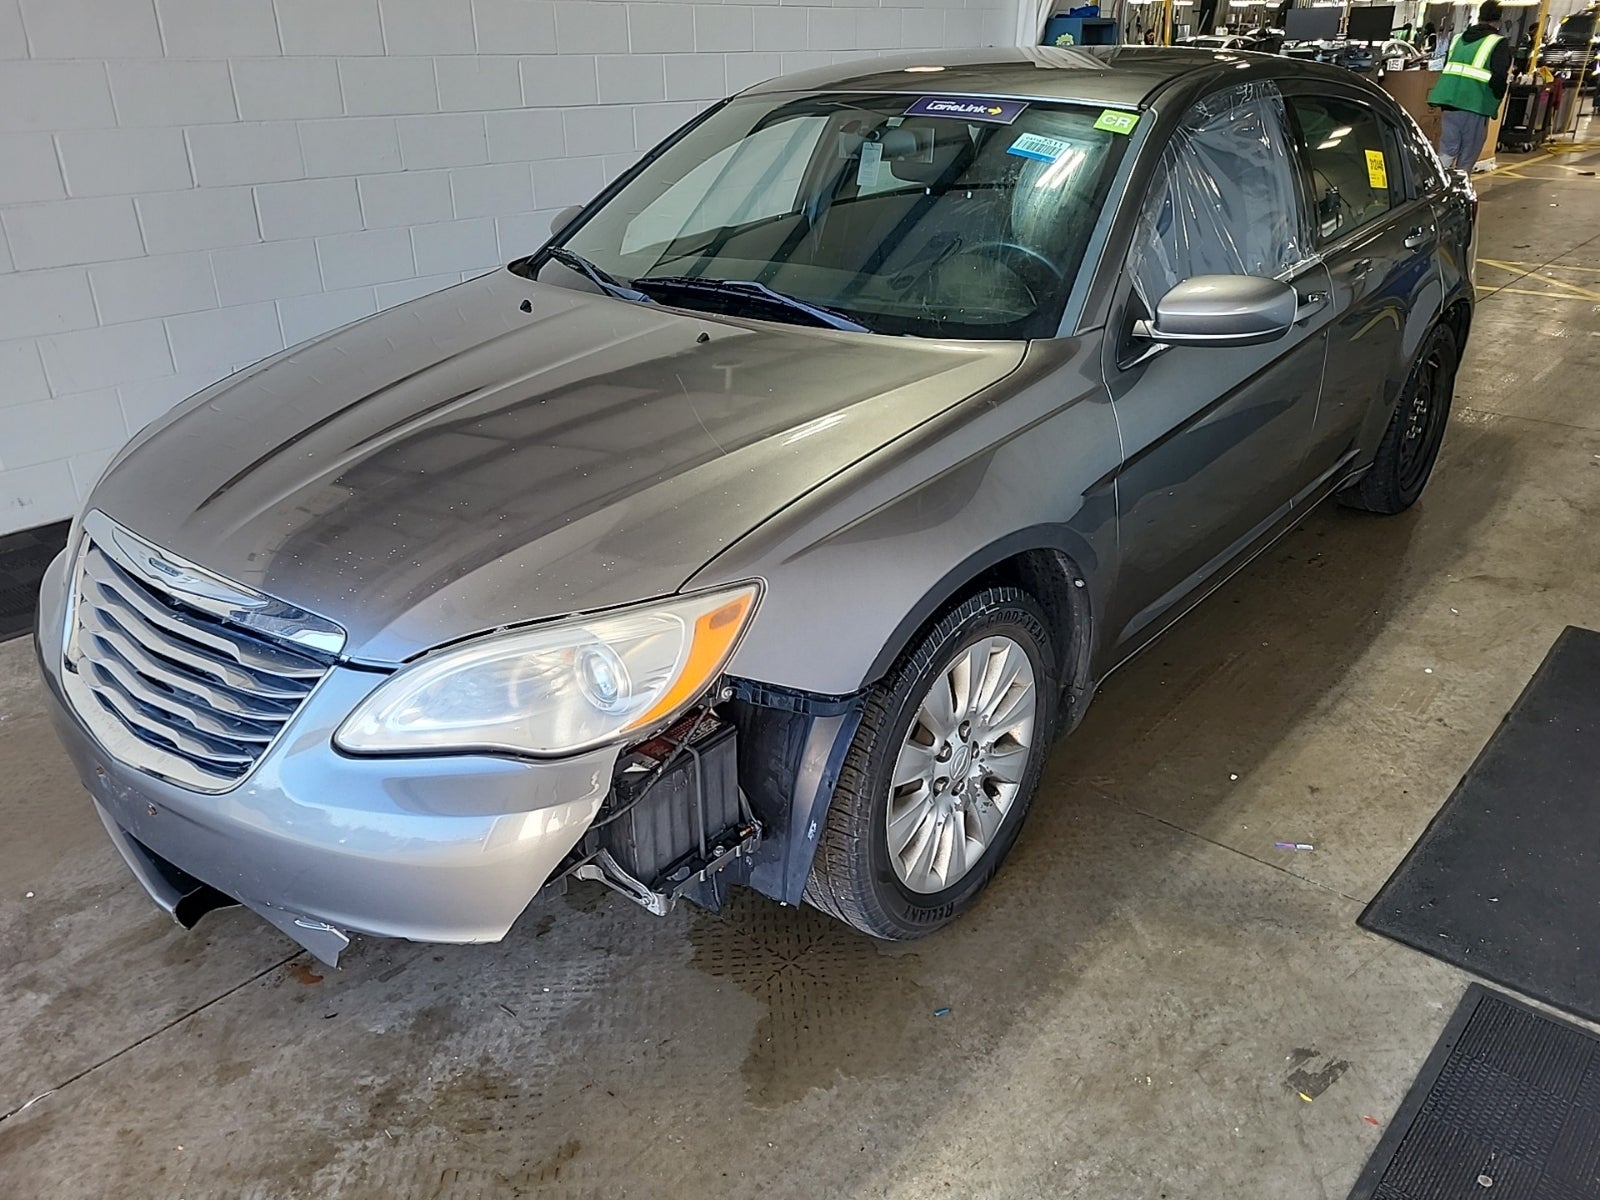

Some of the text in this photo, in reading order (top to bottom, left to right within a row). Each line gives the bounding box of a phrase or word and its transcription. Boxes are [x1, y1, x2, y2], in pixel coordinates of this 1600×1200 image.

[926, 102, 988, 114] LaneLink
[1101, 114, 1132, 128] CR
[986, 610, 1048, 646] GOODYEAR
